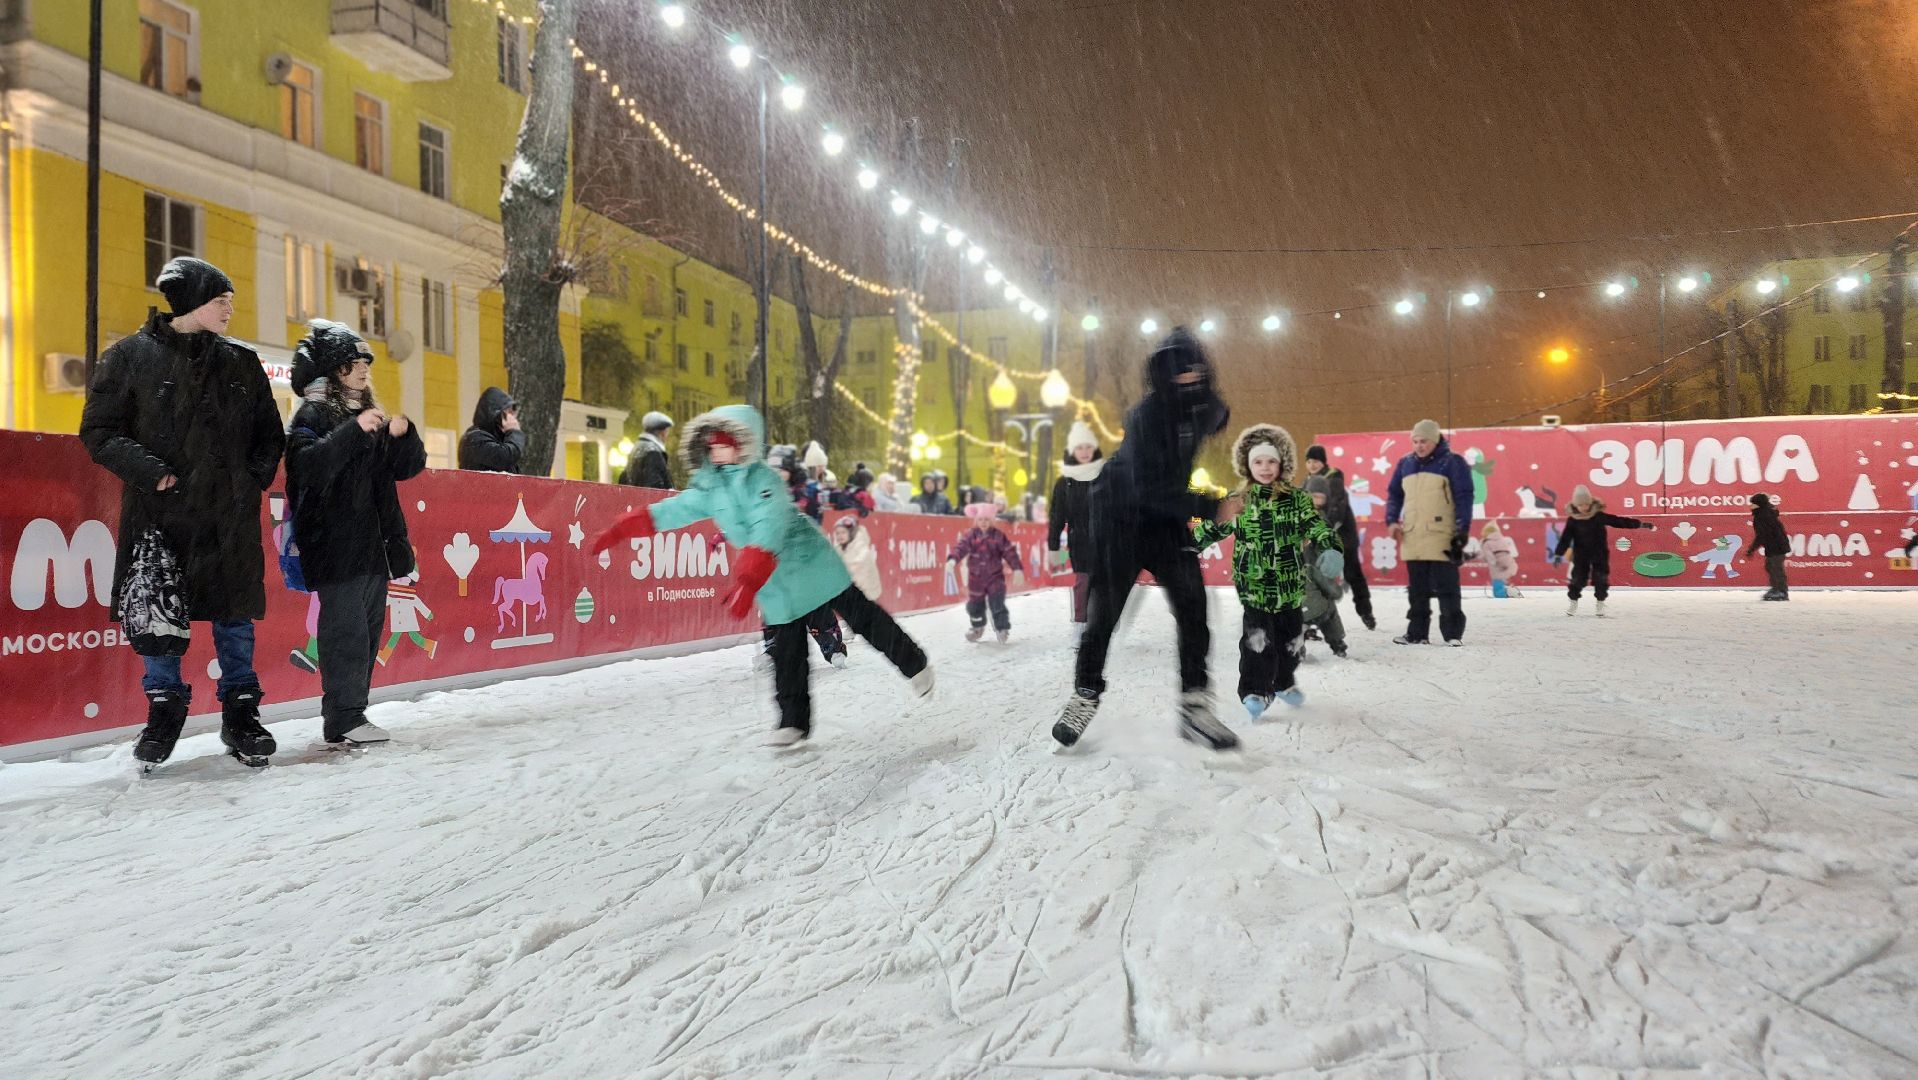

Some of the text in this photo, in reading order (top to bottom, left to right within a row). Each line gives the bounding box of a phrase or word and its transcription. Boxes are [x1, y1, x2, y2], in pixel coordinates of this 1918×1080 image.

[1589, 434, 1820, 487] ЗИМА
[1624, 492, 1782, 510] в Подмоское
[630, 531, 730, 580] ЗИМА
[1784, 532, 1871, 558] ИМА
[647, 586, 716, 603] в Подмосковье
